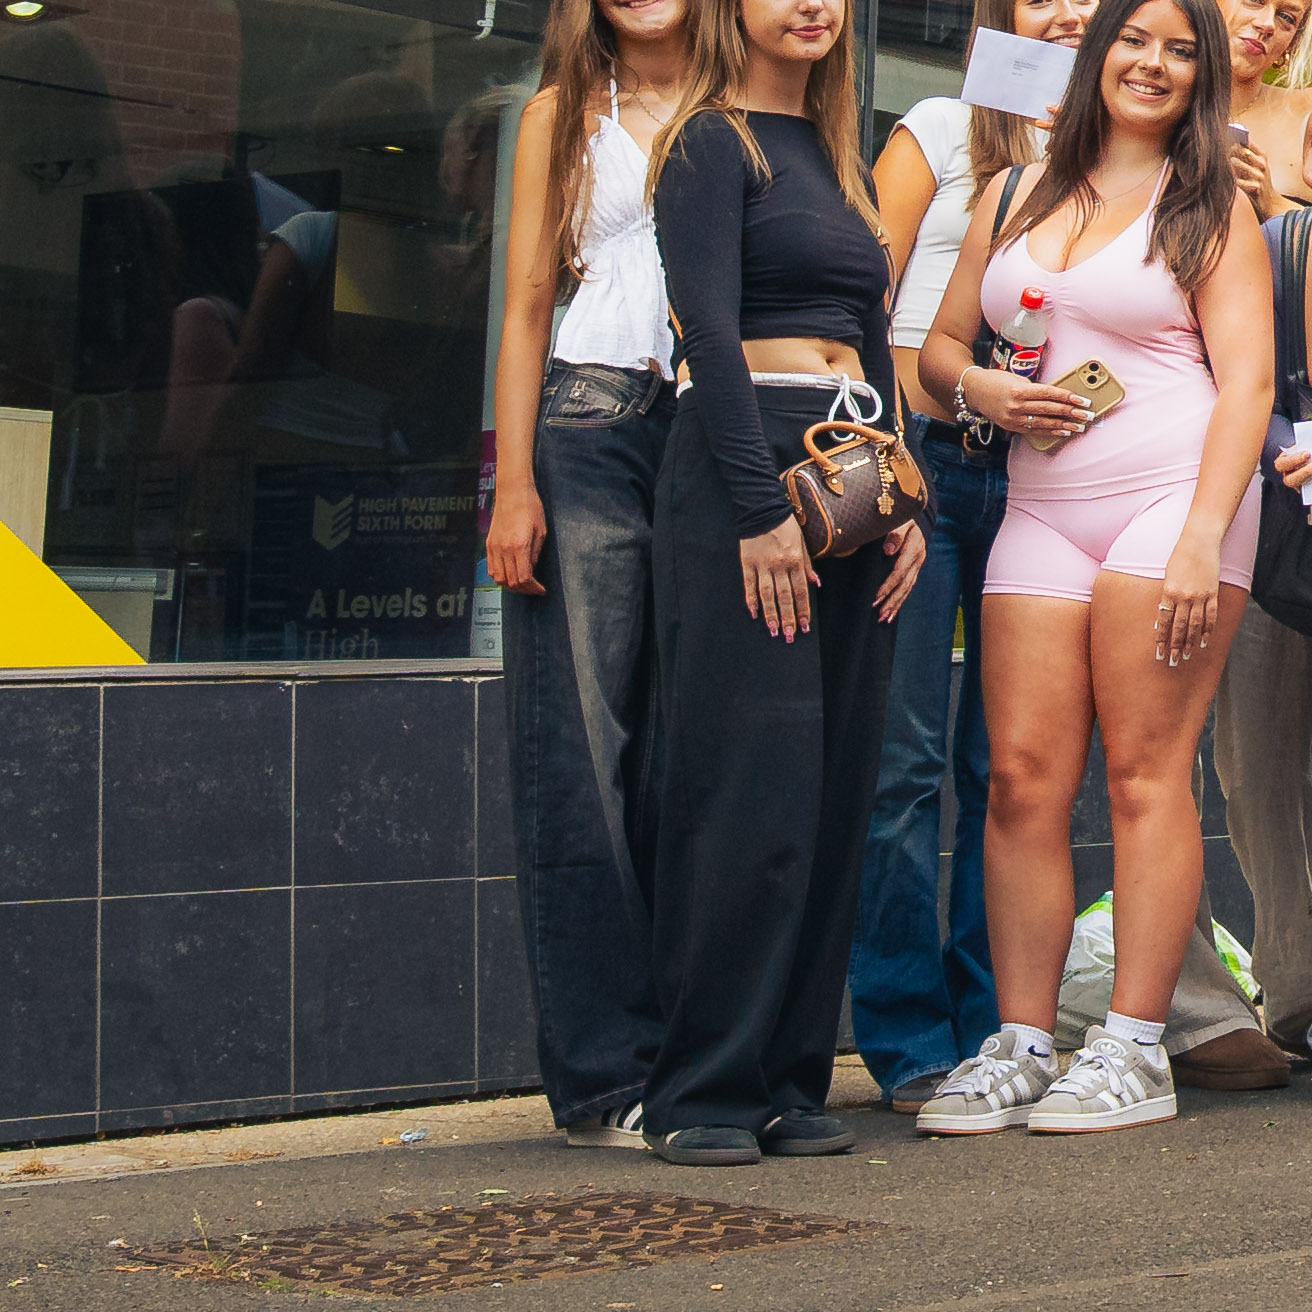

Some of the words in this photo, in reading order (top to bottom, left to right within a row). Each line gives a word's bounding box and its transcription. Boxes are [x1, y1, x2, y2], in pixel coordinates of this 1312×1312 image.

[359, 497, 397, 513] HIGH
[401, 496, 476, 512] PAVEMENT
[357, 515, 400, 531] SIXTH
[404, 514, 448, 530] FORM
[306, 587, 327, 619] A
[337, 586, 428, 619] Levels
[436, 586, 468, 618] at
